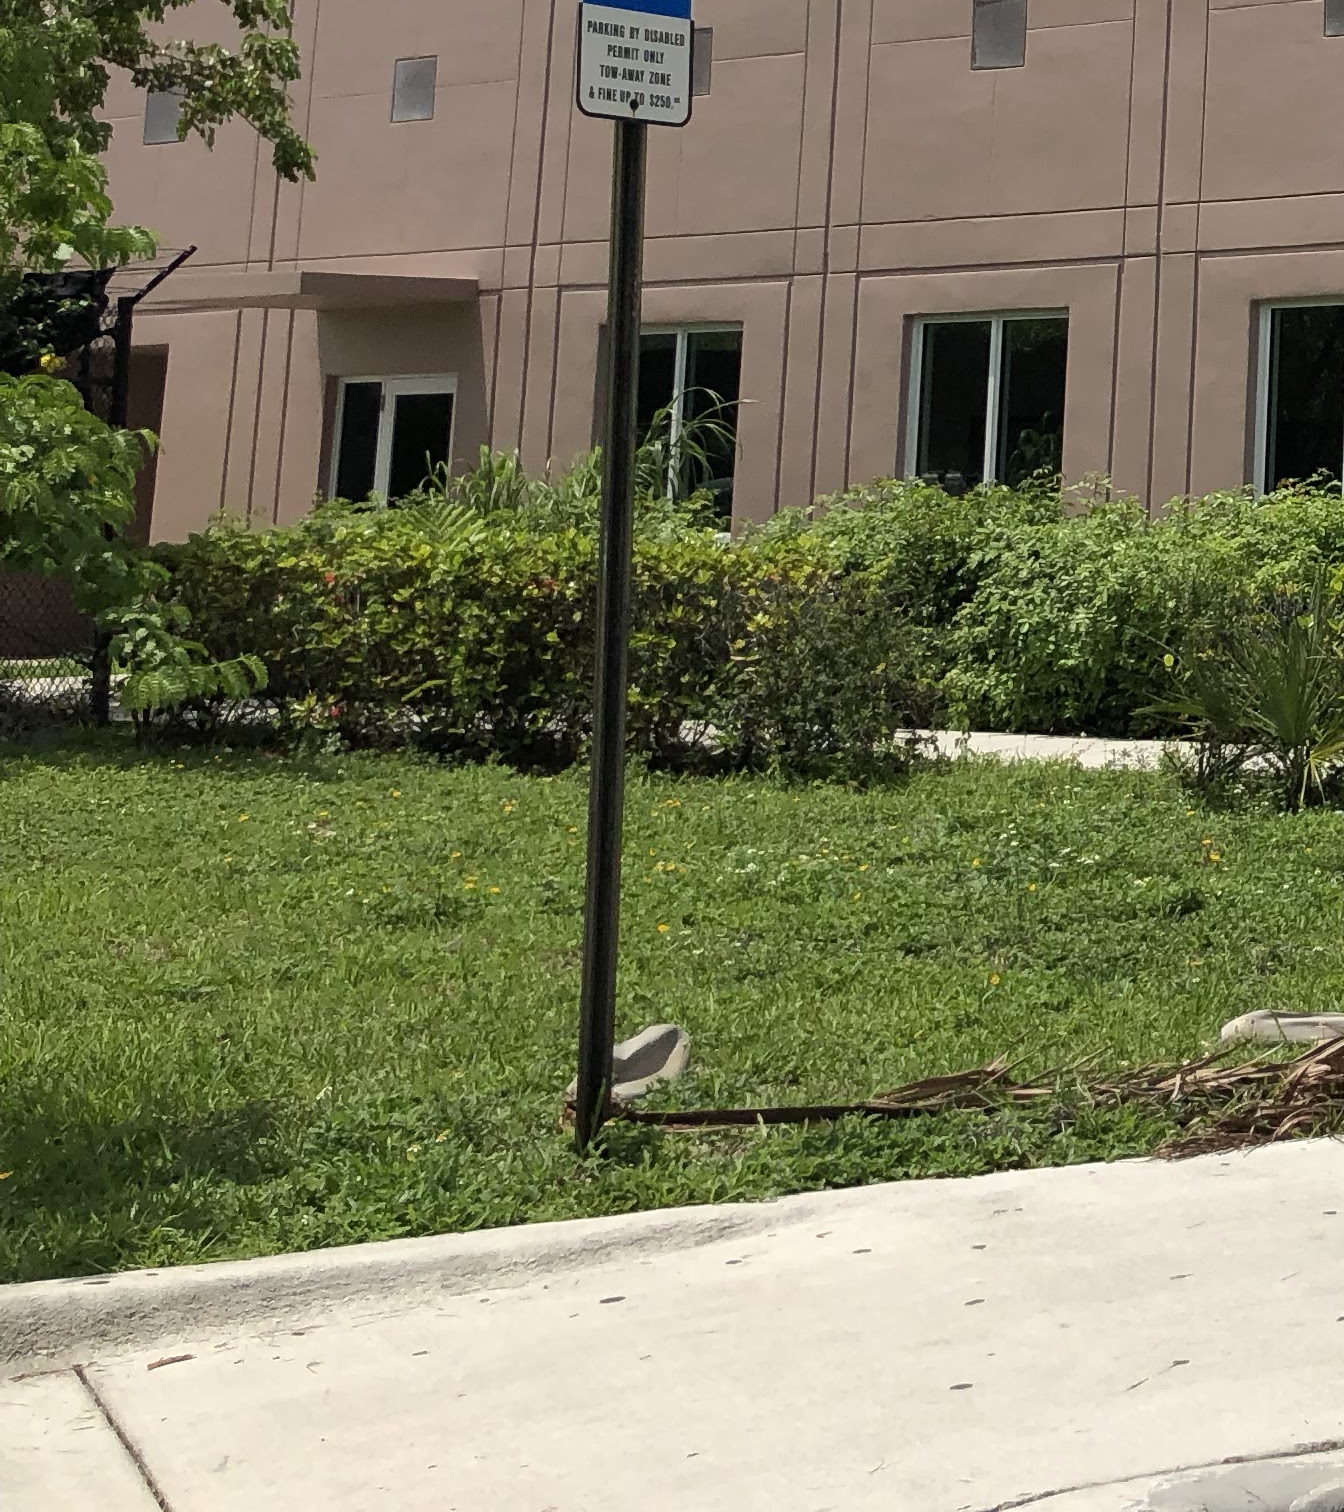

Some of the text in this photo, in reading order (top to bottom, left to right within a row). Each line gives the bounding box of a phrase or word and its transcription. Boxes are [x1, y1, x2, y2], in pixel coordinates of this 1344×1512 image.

[587, 20, 685, 46] PARKING BY DISABLED
[607, 44, 665, 64] PERMIT ONLY
[599, 64, 672, 86] TOW-AWAY ZONE
[588, 85, 595, 99] &
[598, 87, 618, 102] FINE
[619, 90, 631, 103] UP
[633, 92, 645, 106] TO
